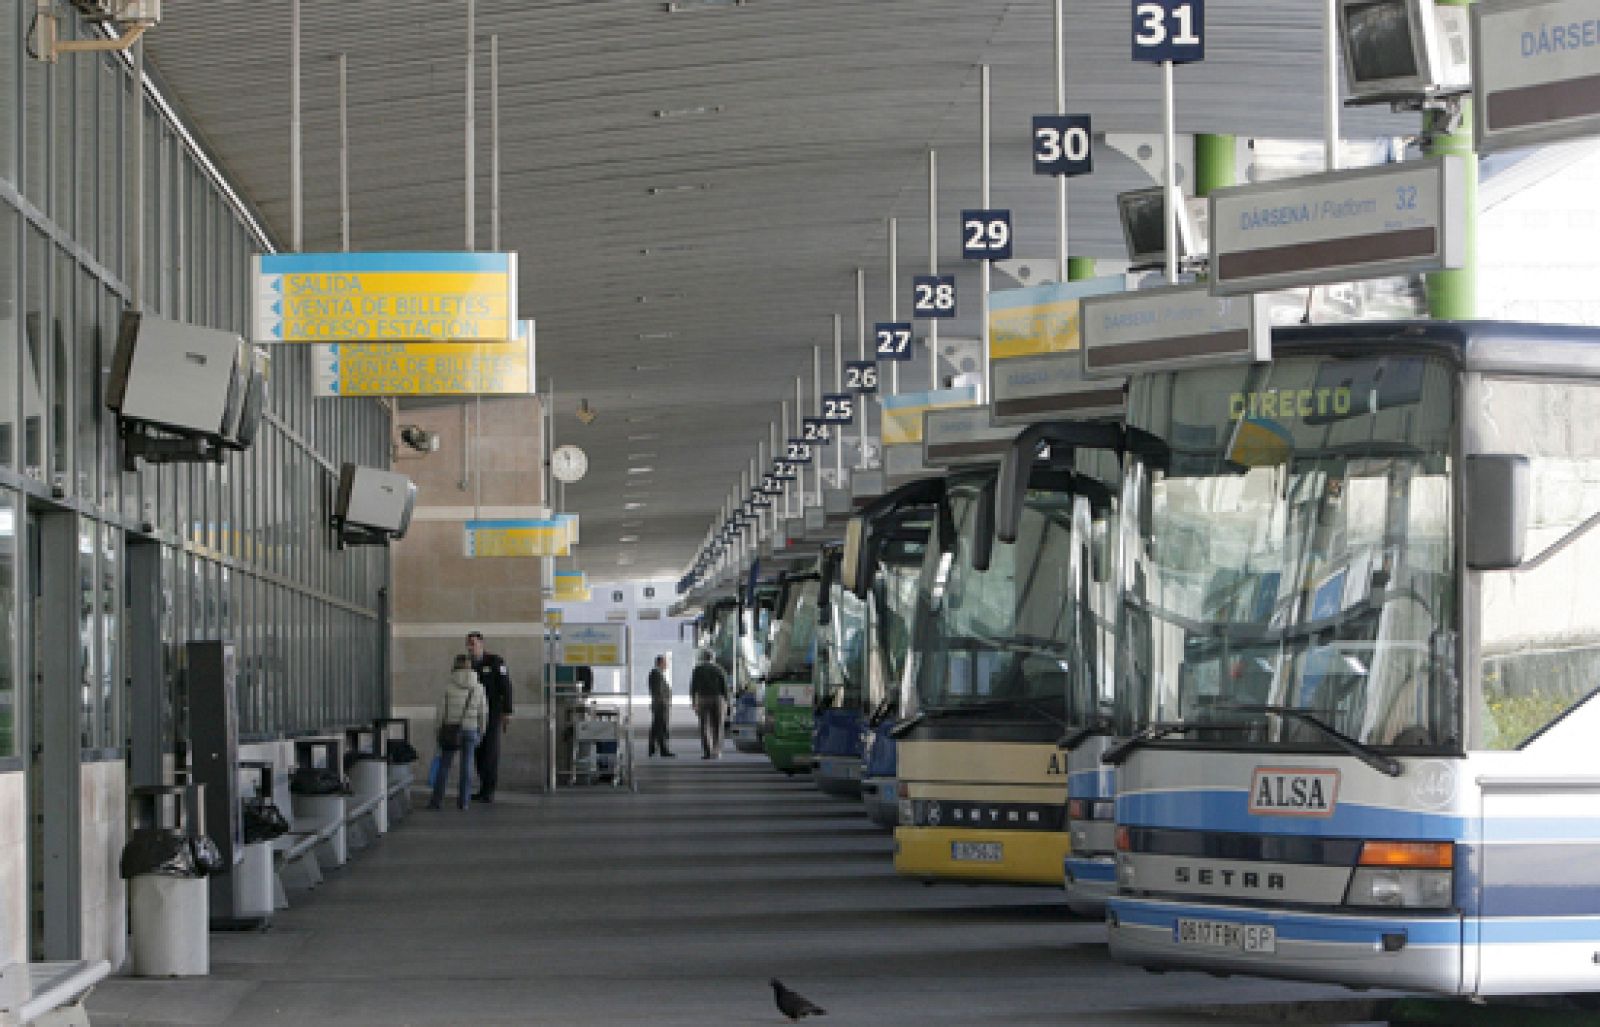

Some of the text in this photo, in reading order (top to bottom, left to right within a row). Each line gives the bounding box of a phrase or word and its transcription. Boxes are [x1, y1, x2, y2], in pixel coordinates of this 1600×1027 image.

[1135, 2, 1200, 46] 31
[1521, 19, 1600, 57] DÁRSE
[1036, 127, 1089, 161] 30
[1395, 185, 1418, 210] 32
[964, 220, 1009, 249] 29
[289, 275, 363, 294] SALIDA
[915, 284, 955, 309] 28
[289, 297, 491, 317] VENTA DE BILLETES
[290, 320, 371, 339] ACCESO
[877, 331, 911, 352] 27
[406, 356, 429, 373] DE
[846, 368, 877, 388] 26
[825, 401, 853, 417] 25
[1230, 387, 1351, 420] DIRECTO
[804, 424, 830, 440] 24
[1255, 775, 1328, 809] ALSA
[1174, 866, 1285, 890] SETRA
